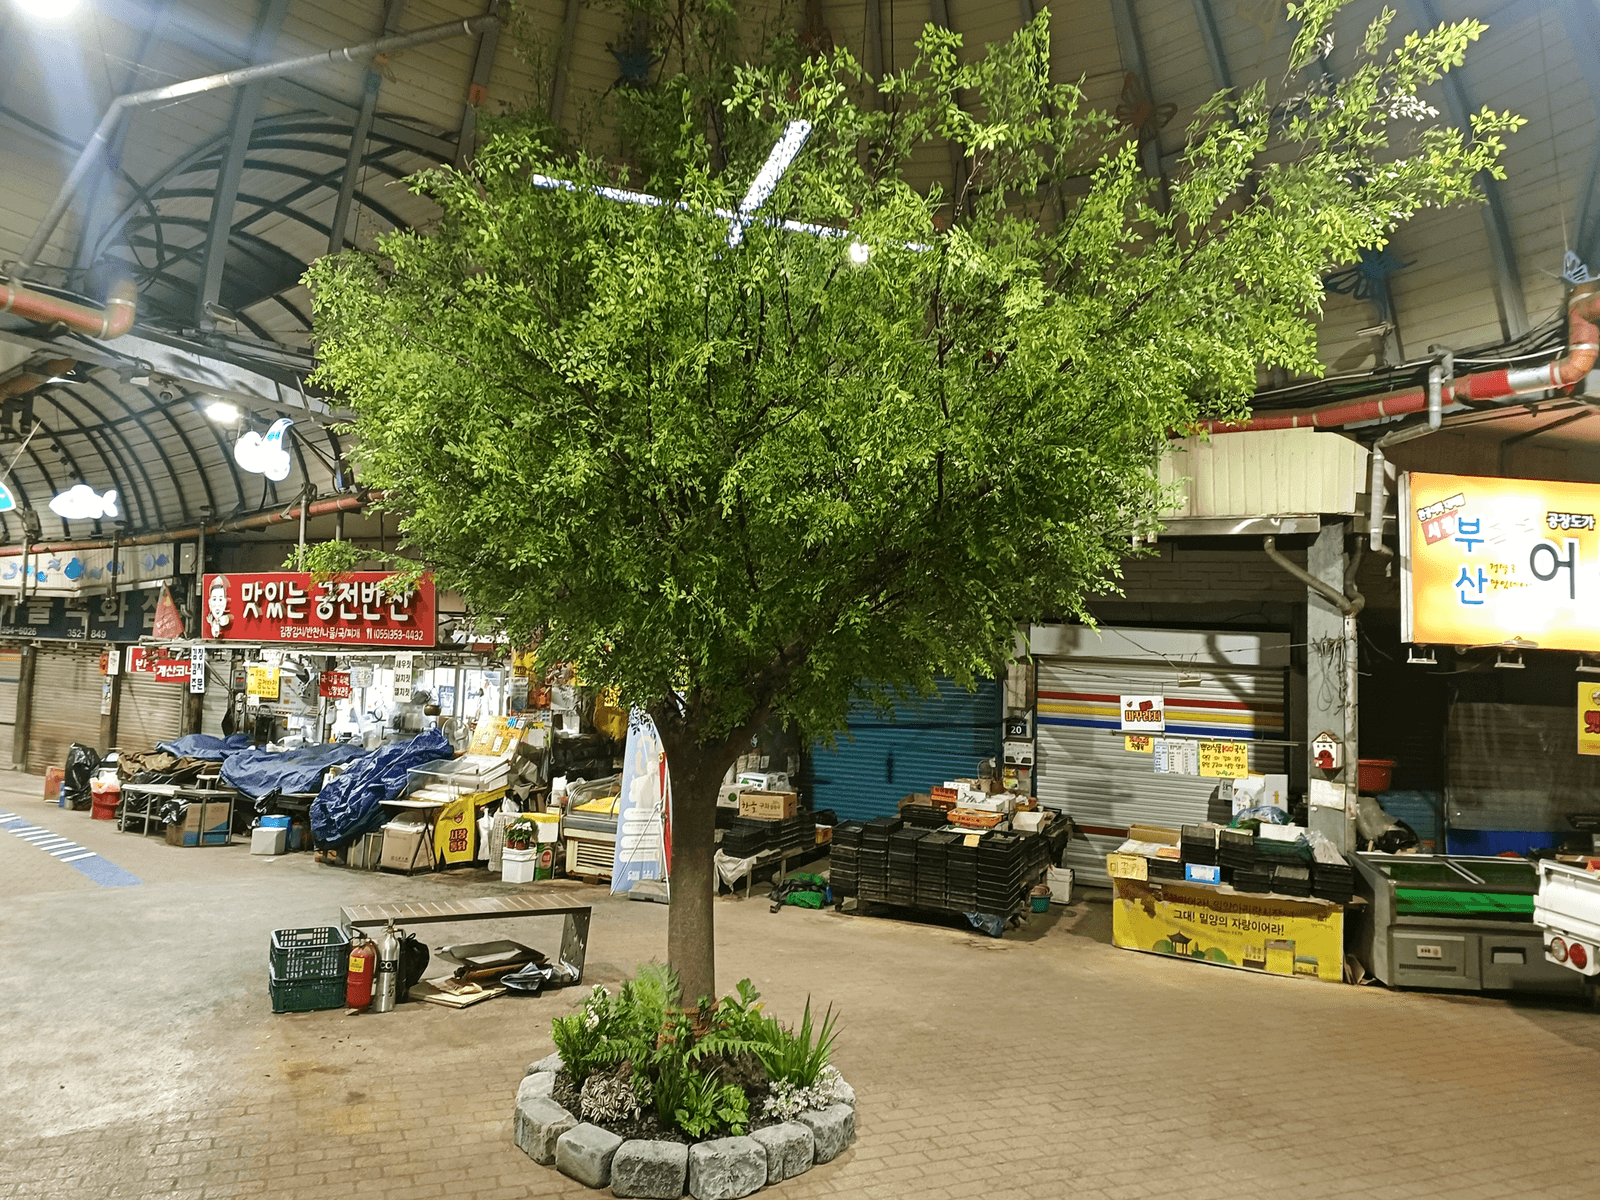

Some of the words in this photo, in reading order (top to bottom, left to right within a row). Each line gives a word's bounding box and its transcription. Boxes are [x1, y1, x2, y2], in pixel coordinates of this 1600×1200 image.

[1546, 511, 1596, 531] 공장도가
[1455, 516, 1489, 605] 부산
[241, 581, 310, 620] 맛있는
[315, 581, 414, 621] 궁전반찬
[373, 628, 424, 641] (055)353-4432
[1011, 725, 1022, 735] 20
[1173, 908, 1196, 922] 그대!
[1199, 911, 1229, 927] 밀양의
[1232, 917, 1285, 936] 자랑이어라!
